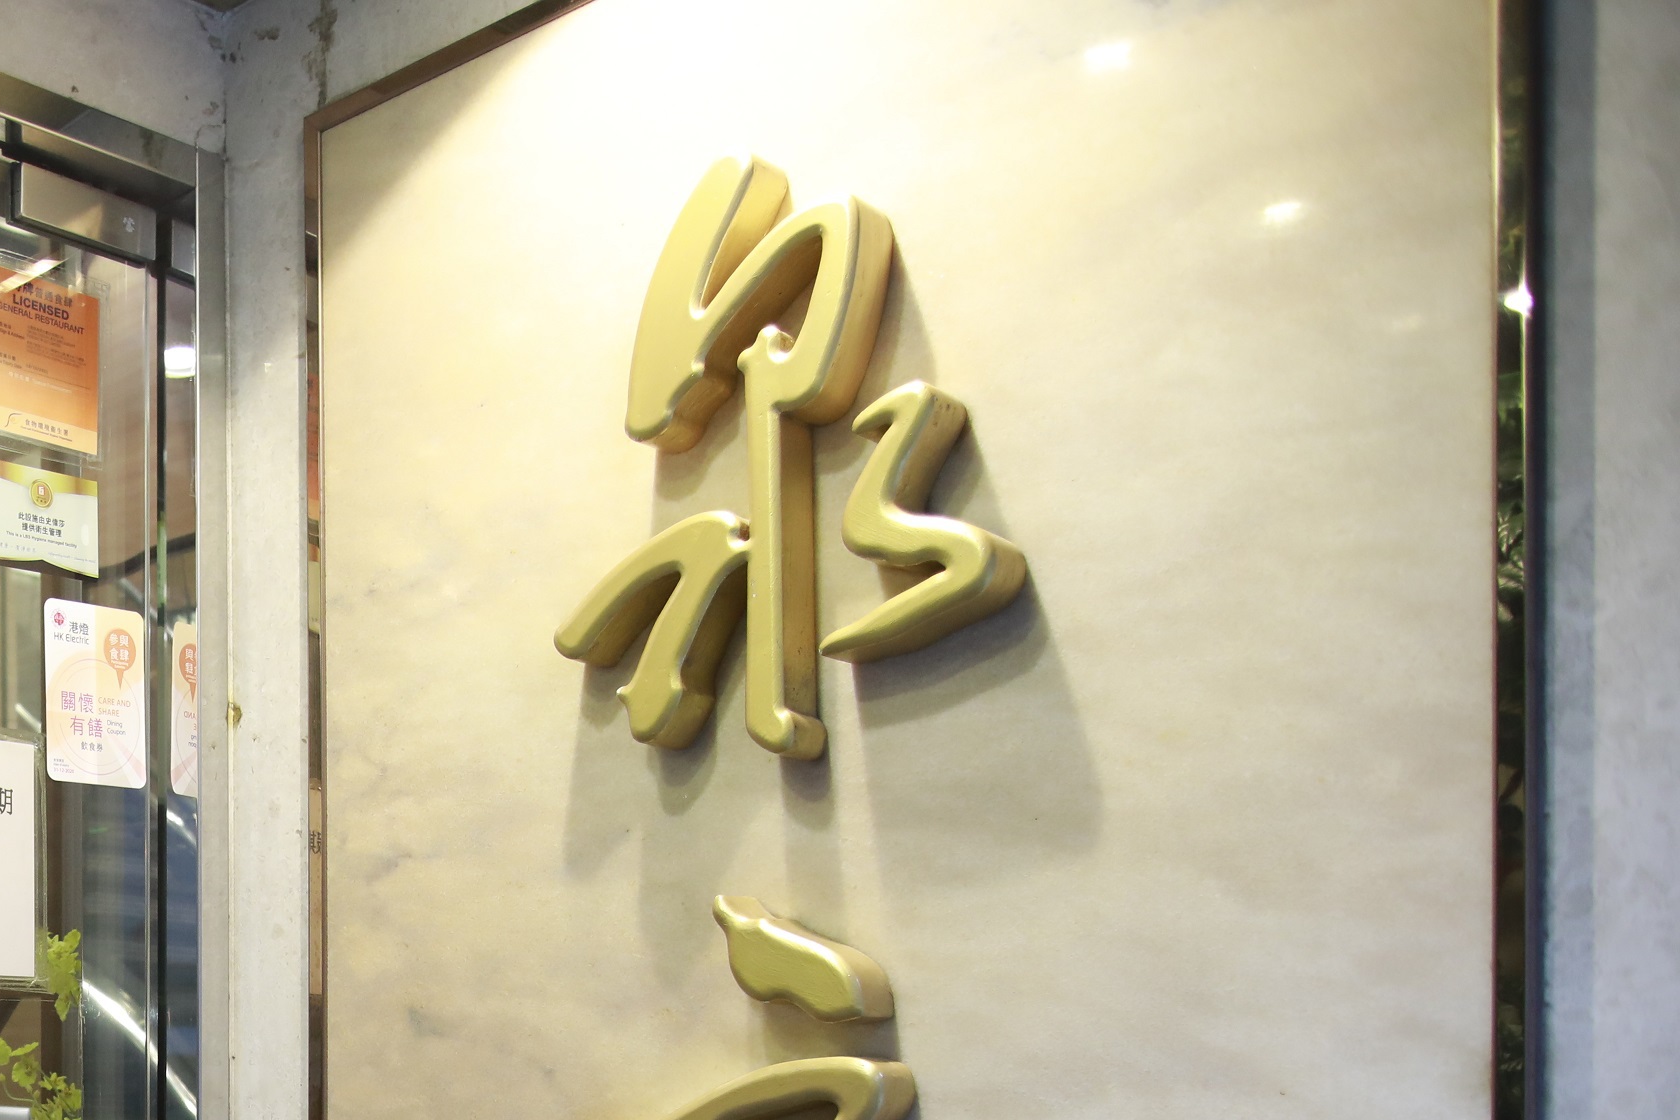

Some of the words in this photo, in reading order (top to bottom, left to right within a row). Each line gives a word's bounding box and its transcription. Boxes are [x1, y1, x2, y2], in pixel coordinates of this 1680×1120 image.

[13, 293, 69, 320] LICENSED
[34, 313, 85, 335] RESTAURANT
[69, 621, 89, 636] 港燈
[53, 632, 64, 641] HK
[65, 633, 89, 645] Electric
[61, 690, 94, 714] 關懷
[98, 696, 115, 706] CARE
[116, 699, 131, 708] AND
[98, 707, 120, 718] SHARE
[106, 719, 123, 728] Dining
[106, 728, 126, 736] Coupon
